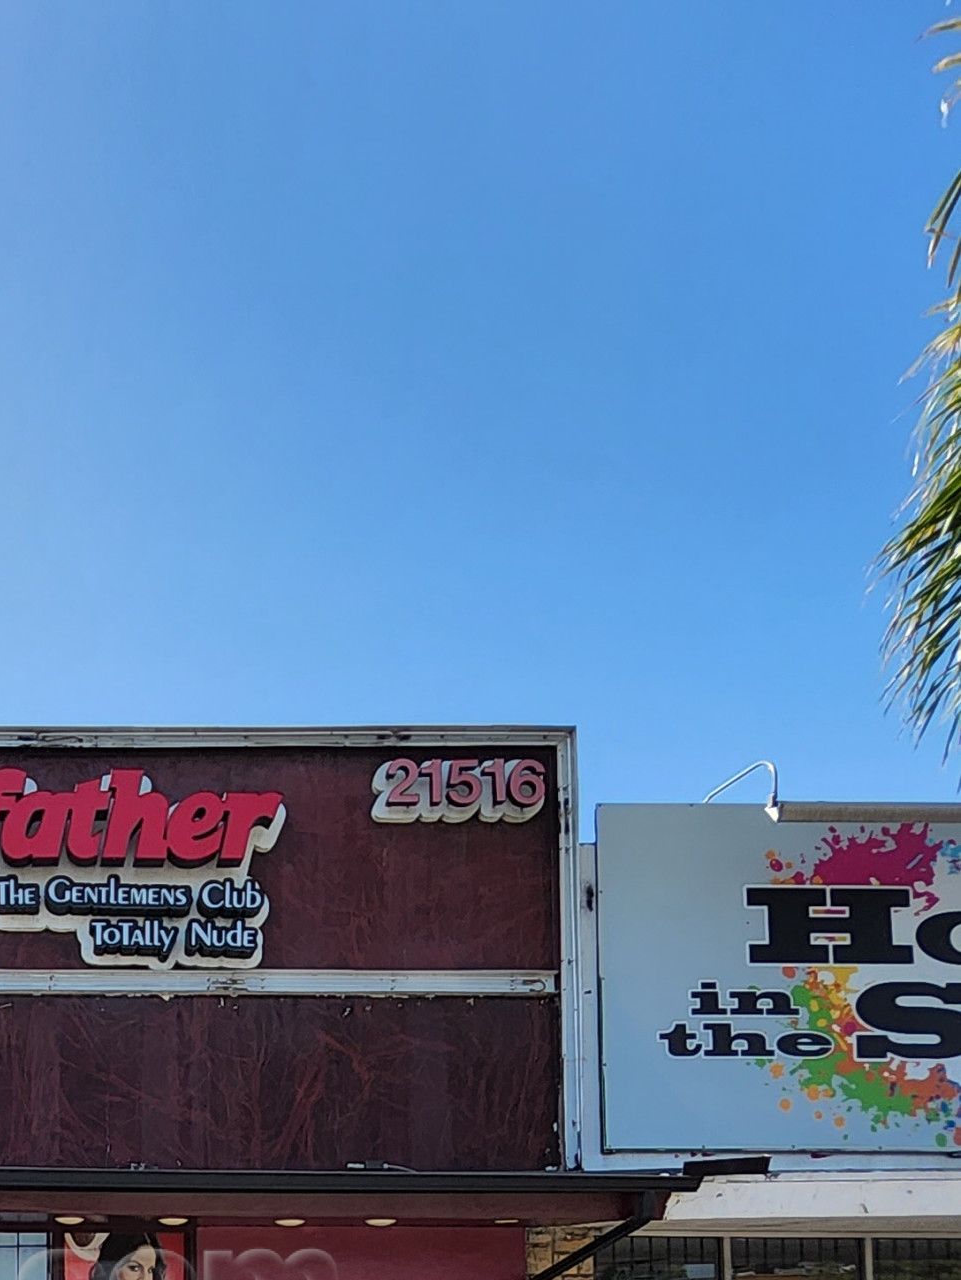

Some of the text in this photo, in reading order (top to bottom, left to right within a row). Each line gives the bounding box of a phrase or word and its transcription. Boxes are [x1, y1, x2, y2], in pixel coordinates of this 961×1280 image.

[385, 757, 547, 806] 21516
[201, 880, 262, 909] Club
[690, 981, 800, 1016] in
[658, 1022, 834, 1058] the
